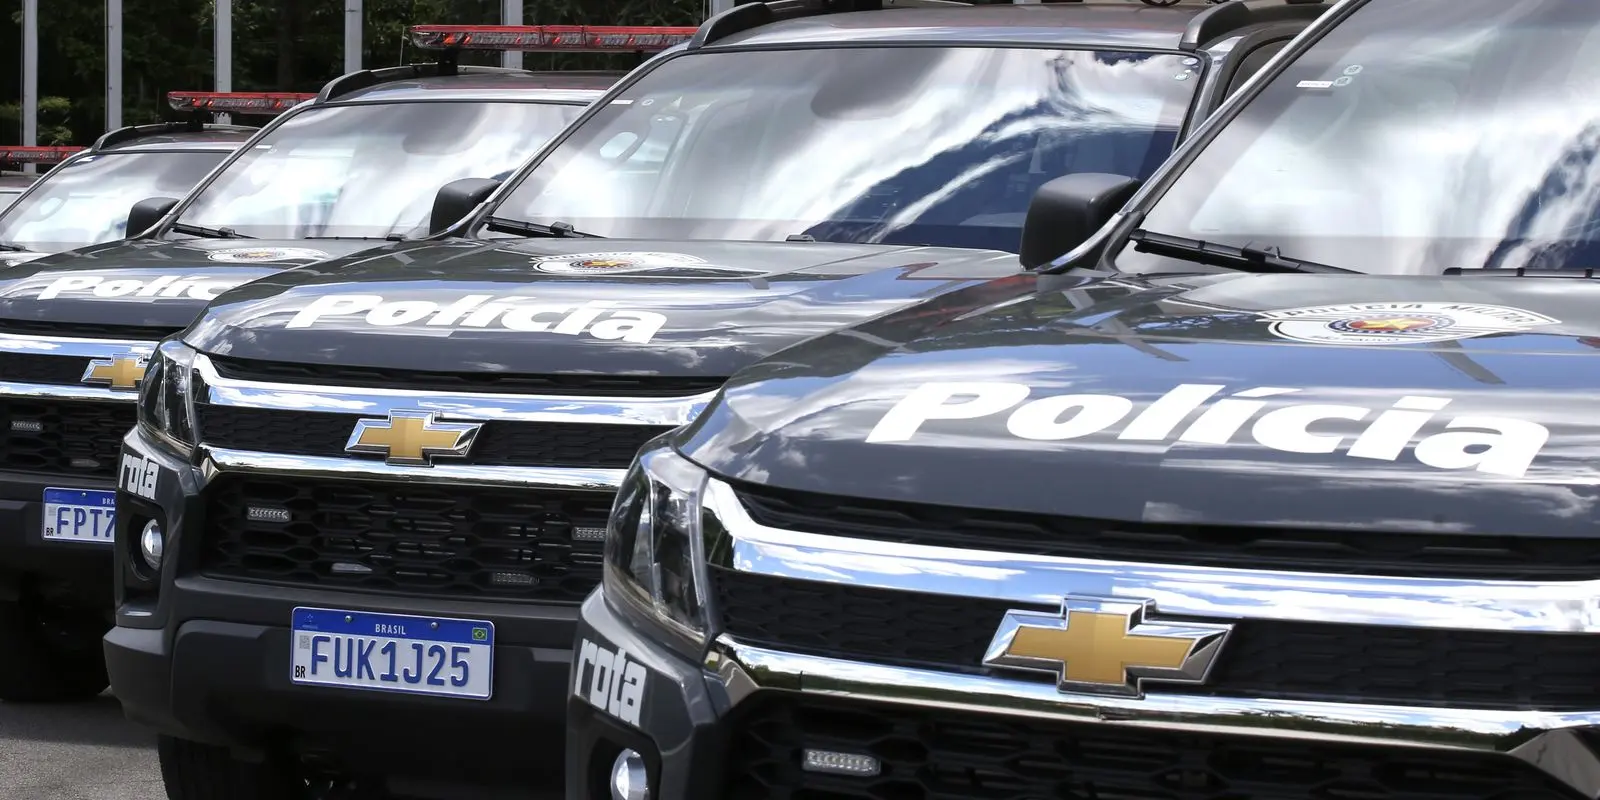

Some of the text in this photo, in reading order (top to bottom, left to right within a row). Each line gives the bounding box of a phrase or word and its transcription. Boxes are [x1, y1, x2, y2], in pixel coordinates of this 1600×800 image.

[37, 275, 233, 301] Políc
[285, 294, 668, 344] Polícia
[865, 382, 1550, 478] Polícia
[118, 453, 160, 500] rota
[46, 527, 54, 537] BR
[56, 507, 115, 538] FPT7
[375, 623, 406, 635] BRASIL
[295, 665, 306, 679] BR
[311, 635, 471, 687] FUK1J25
[574, 637, 647, 728] rota
